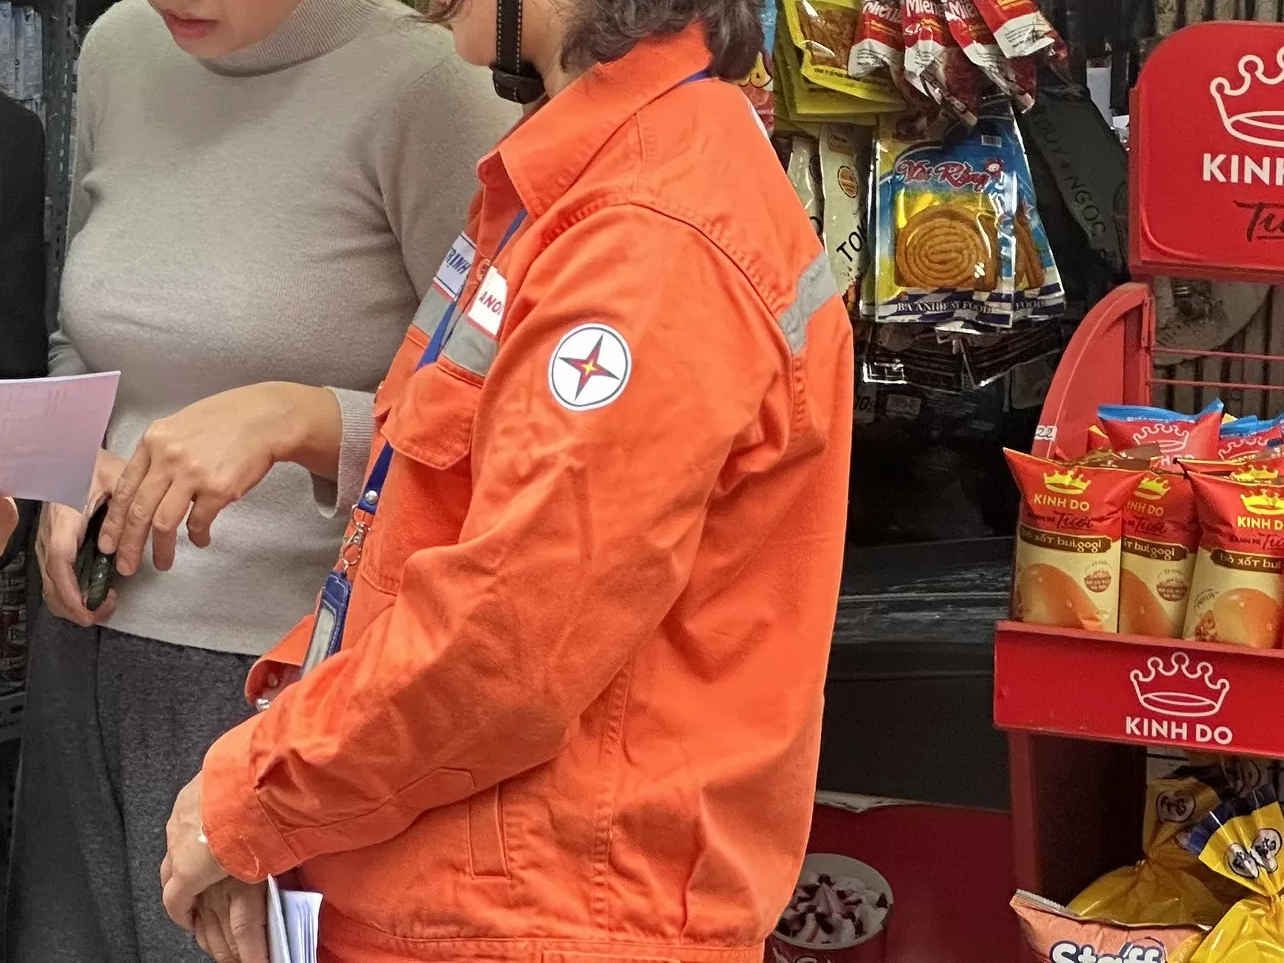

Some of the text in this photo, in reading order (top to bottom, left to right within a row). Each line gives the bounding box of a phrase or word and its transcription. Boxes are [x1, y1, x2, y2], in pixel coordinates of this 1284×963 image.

[1033, 493, 1091, 513] KINH DO
[1126, 500, 1165, 518] INH DO
[1237, 515, 1271, 531] KINH
[1057, 535, 1103, 553] bulgogi
[1134, 541, 1176, 562] bulgogi
[1236, 553, 1260, 567] xốt
[1125, 716, 1234, 745] KINH DO
